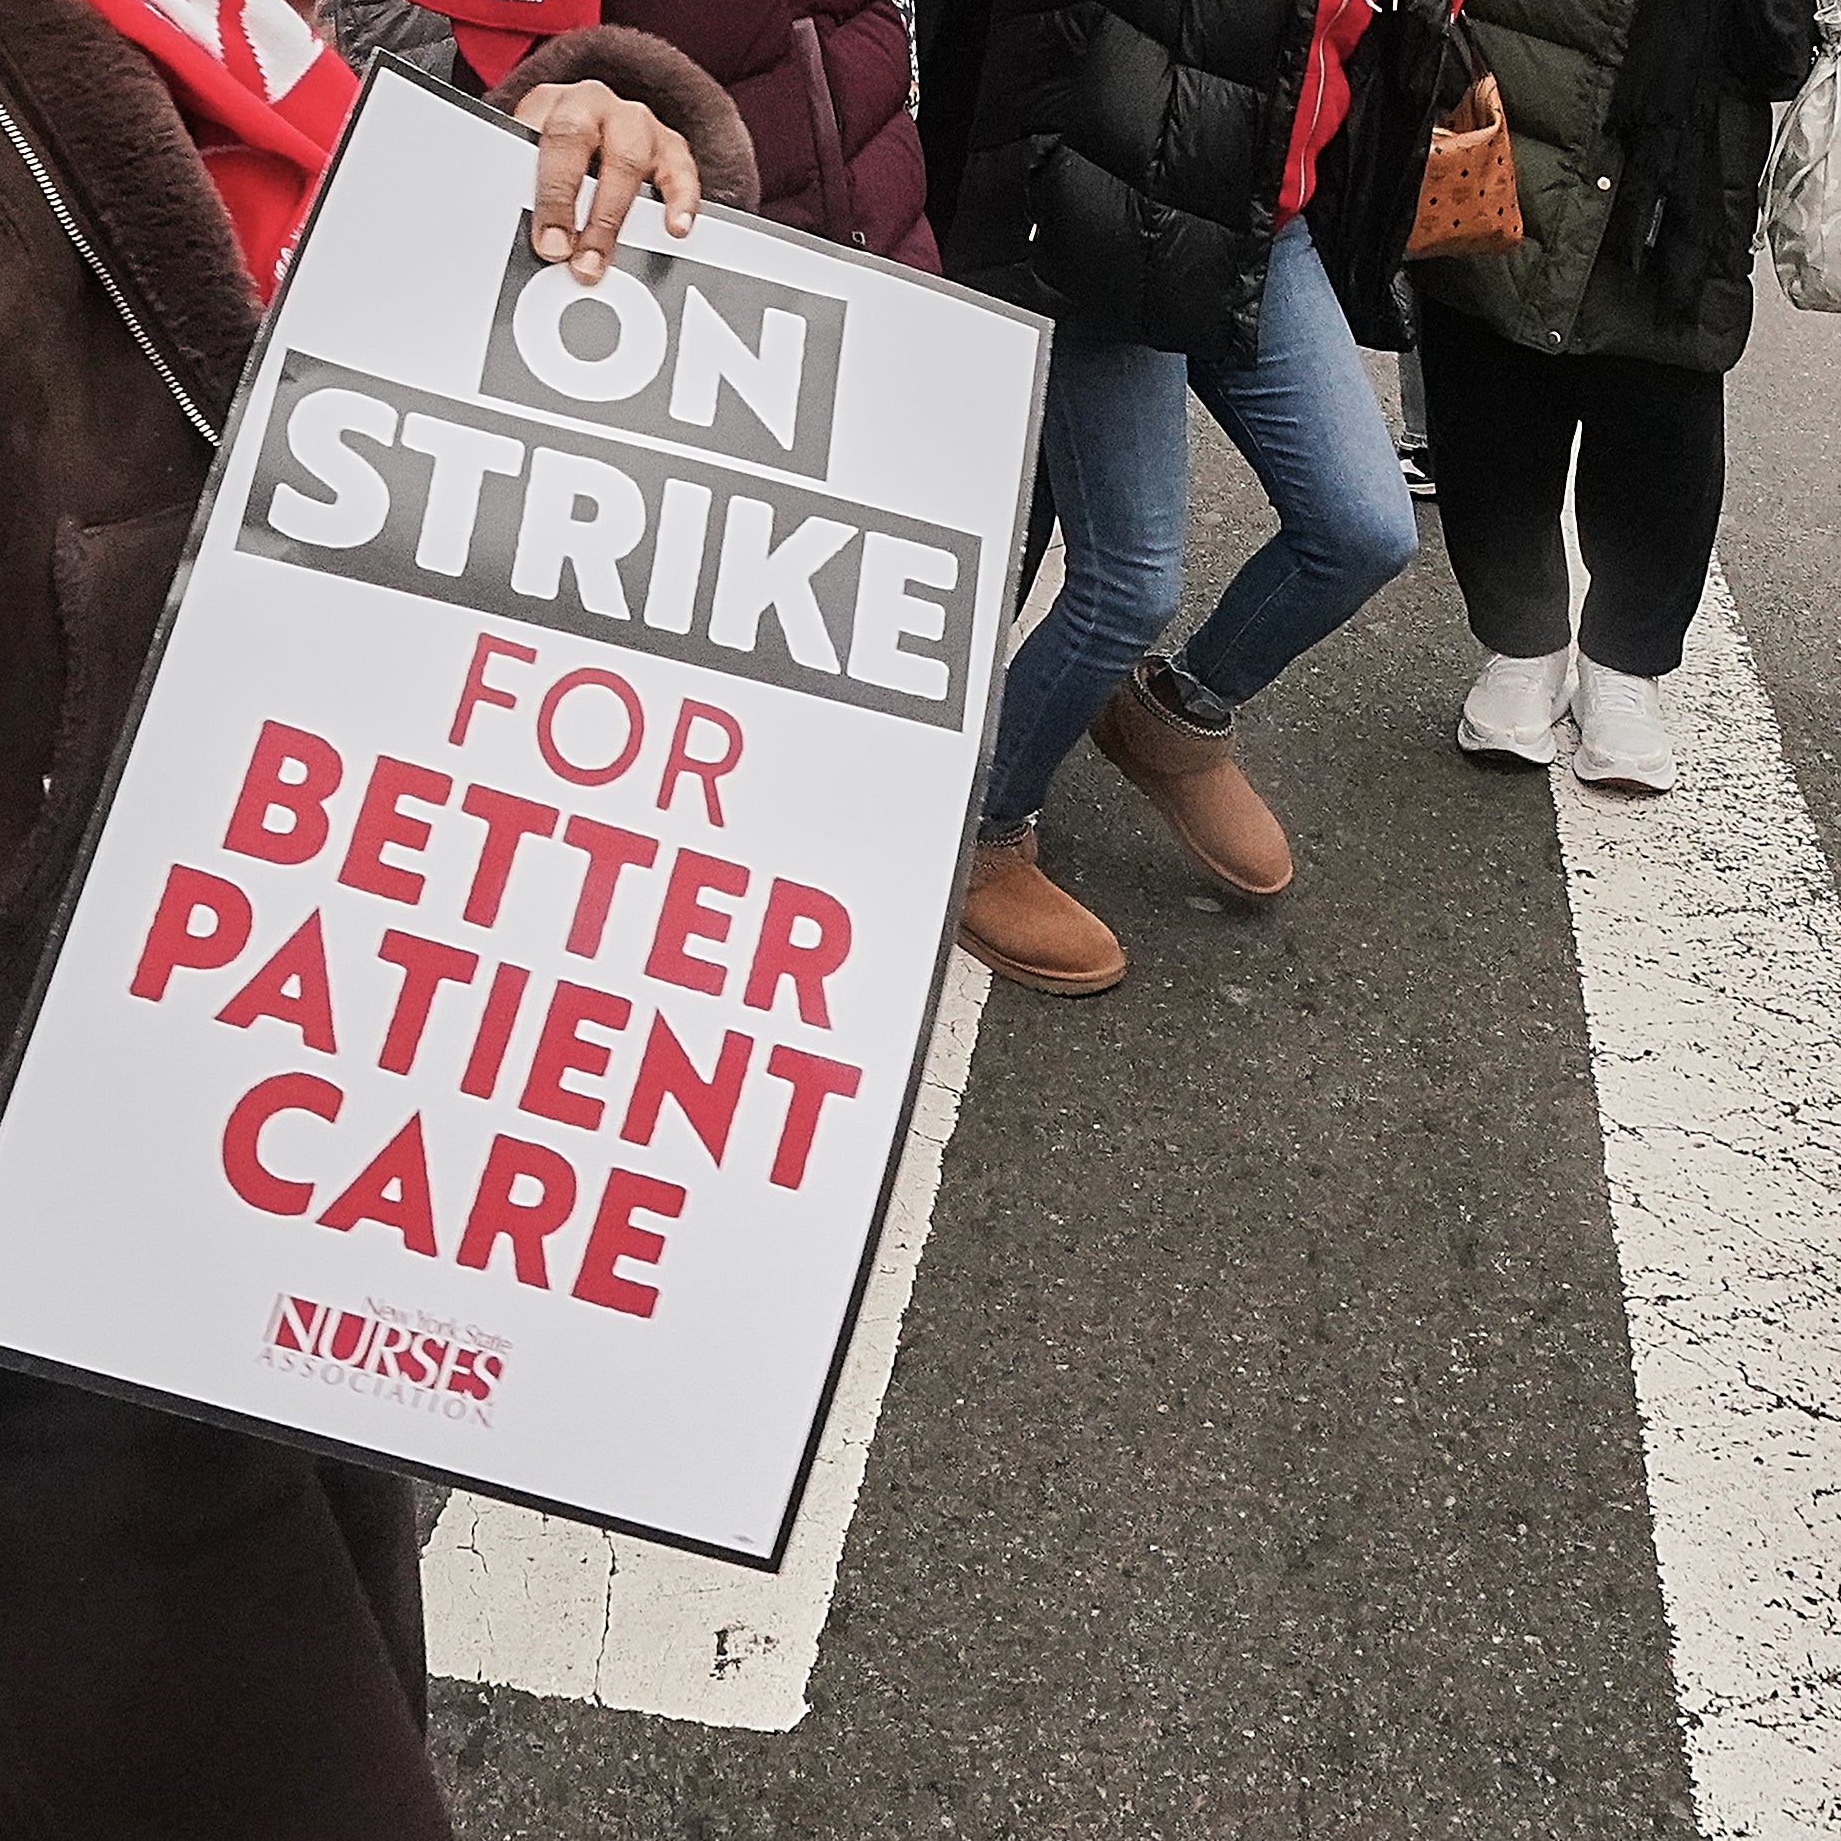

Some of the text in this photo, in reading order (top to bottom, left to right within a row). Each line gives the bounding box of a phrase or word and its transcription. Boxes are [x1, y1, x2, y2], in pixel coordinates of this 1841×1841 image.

[512, 261, 807, 452] ON
[266, 388, 959, 701] STRIKE
[447, 631, 744, 830] FOR
[221, 719, 853, 1031] BETTER
[129, 863, 862, 1190] PATIENT
[221, 1070, 687, 1319] CARE
[255, 1346, 495, 1429] ASSOCIATION
[263, 1292, 507, 1402] NURSES
